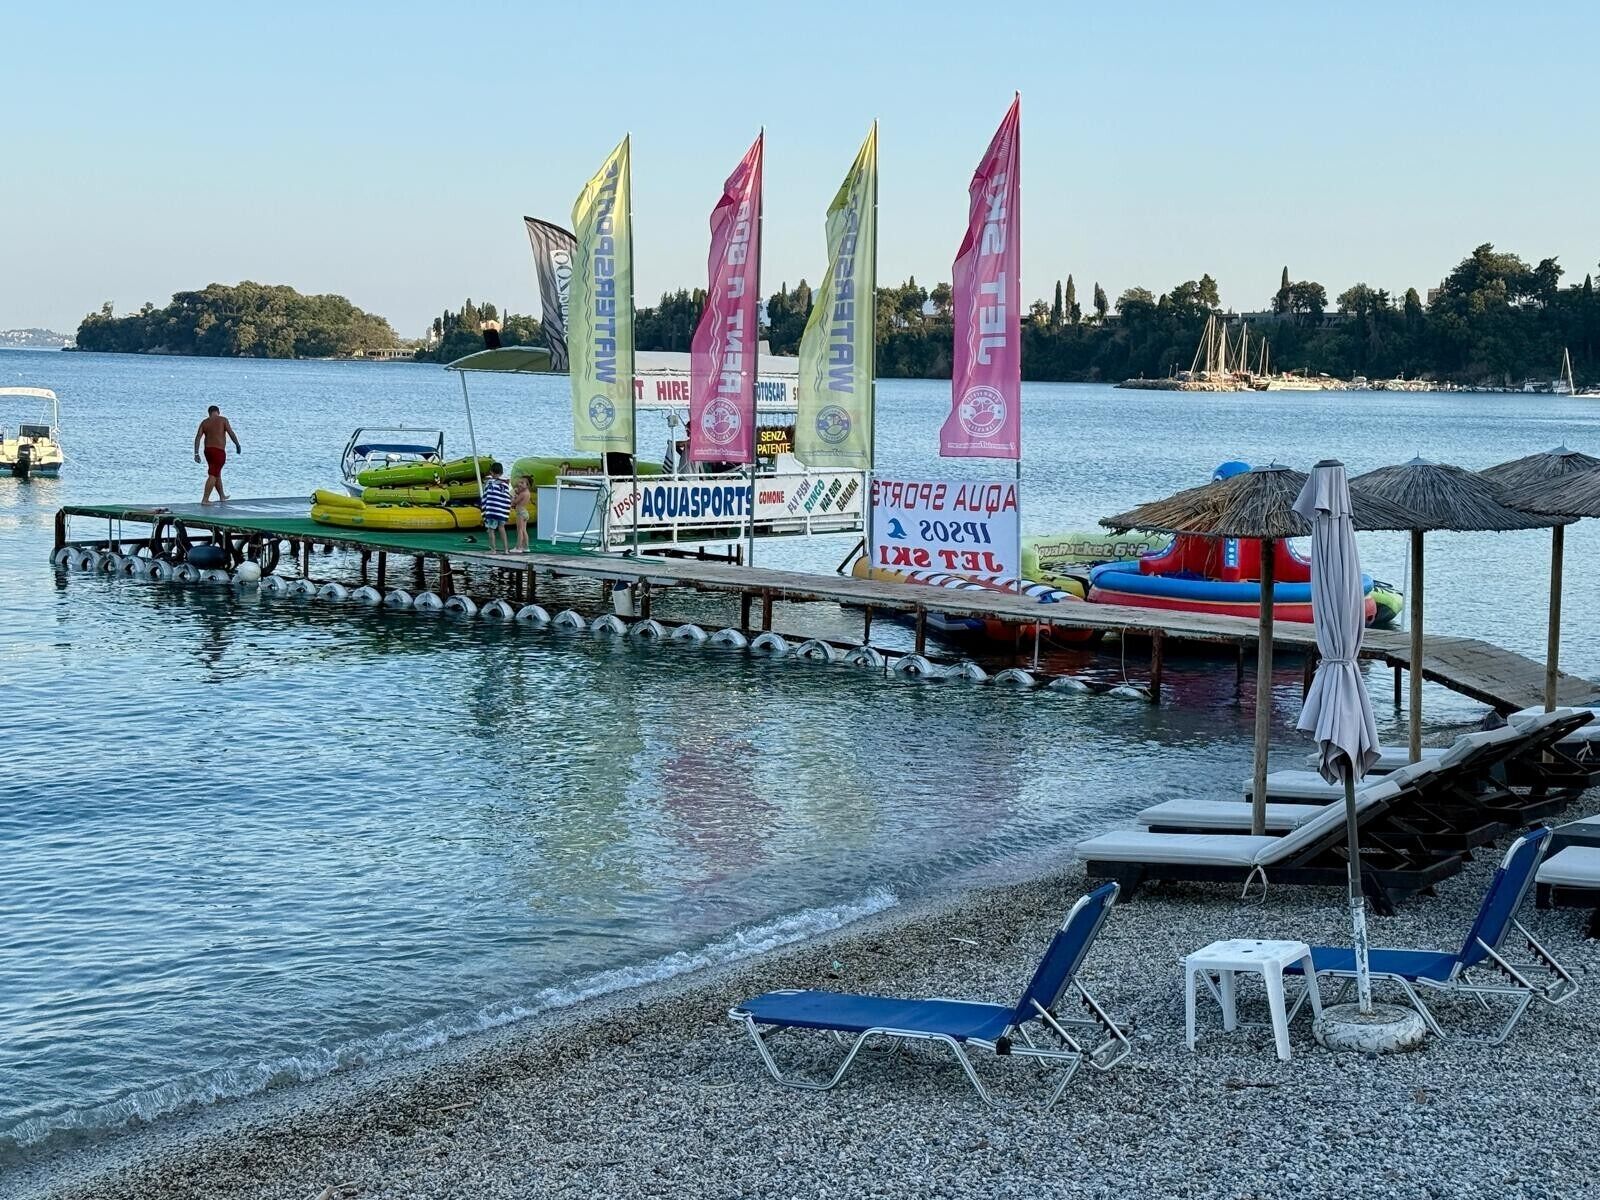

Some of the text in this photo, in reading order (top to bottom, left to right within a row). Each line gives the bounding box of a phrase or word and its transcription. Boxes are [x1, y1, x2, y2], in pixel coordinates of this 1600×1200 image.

[656, 380, 690, 401] HIRE
[757, 382, 786, 402] OTOSCAFI
[760, 431, 787, 442] SENZA
[757, 443, 792, 455] PATENTE
[641, 485, 752, 521] AQUASPORTS
[804, 479, 826, 513] RINGO
[835, 478, 859, 512] BANANA
